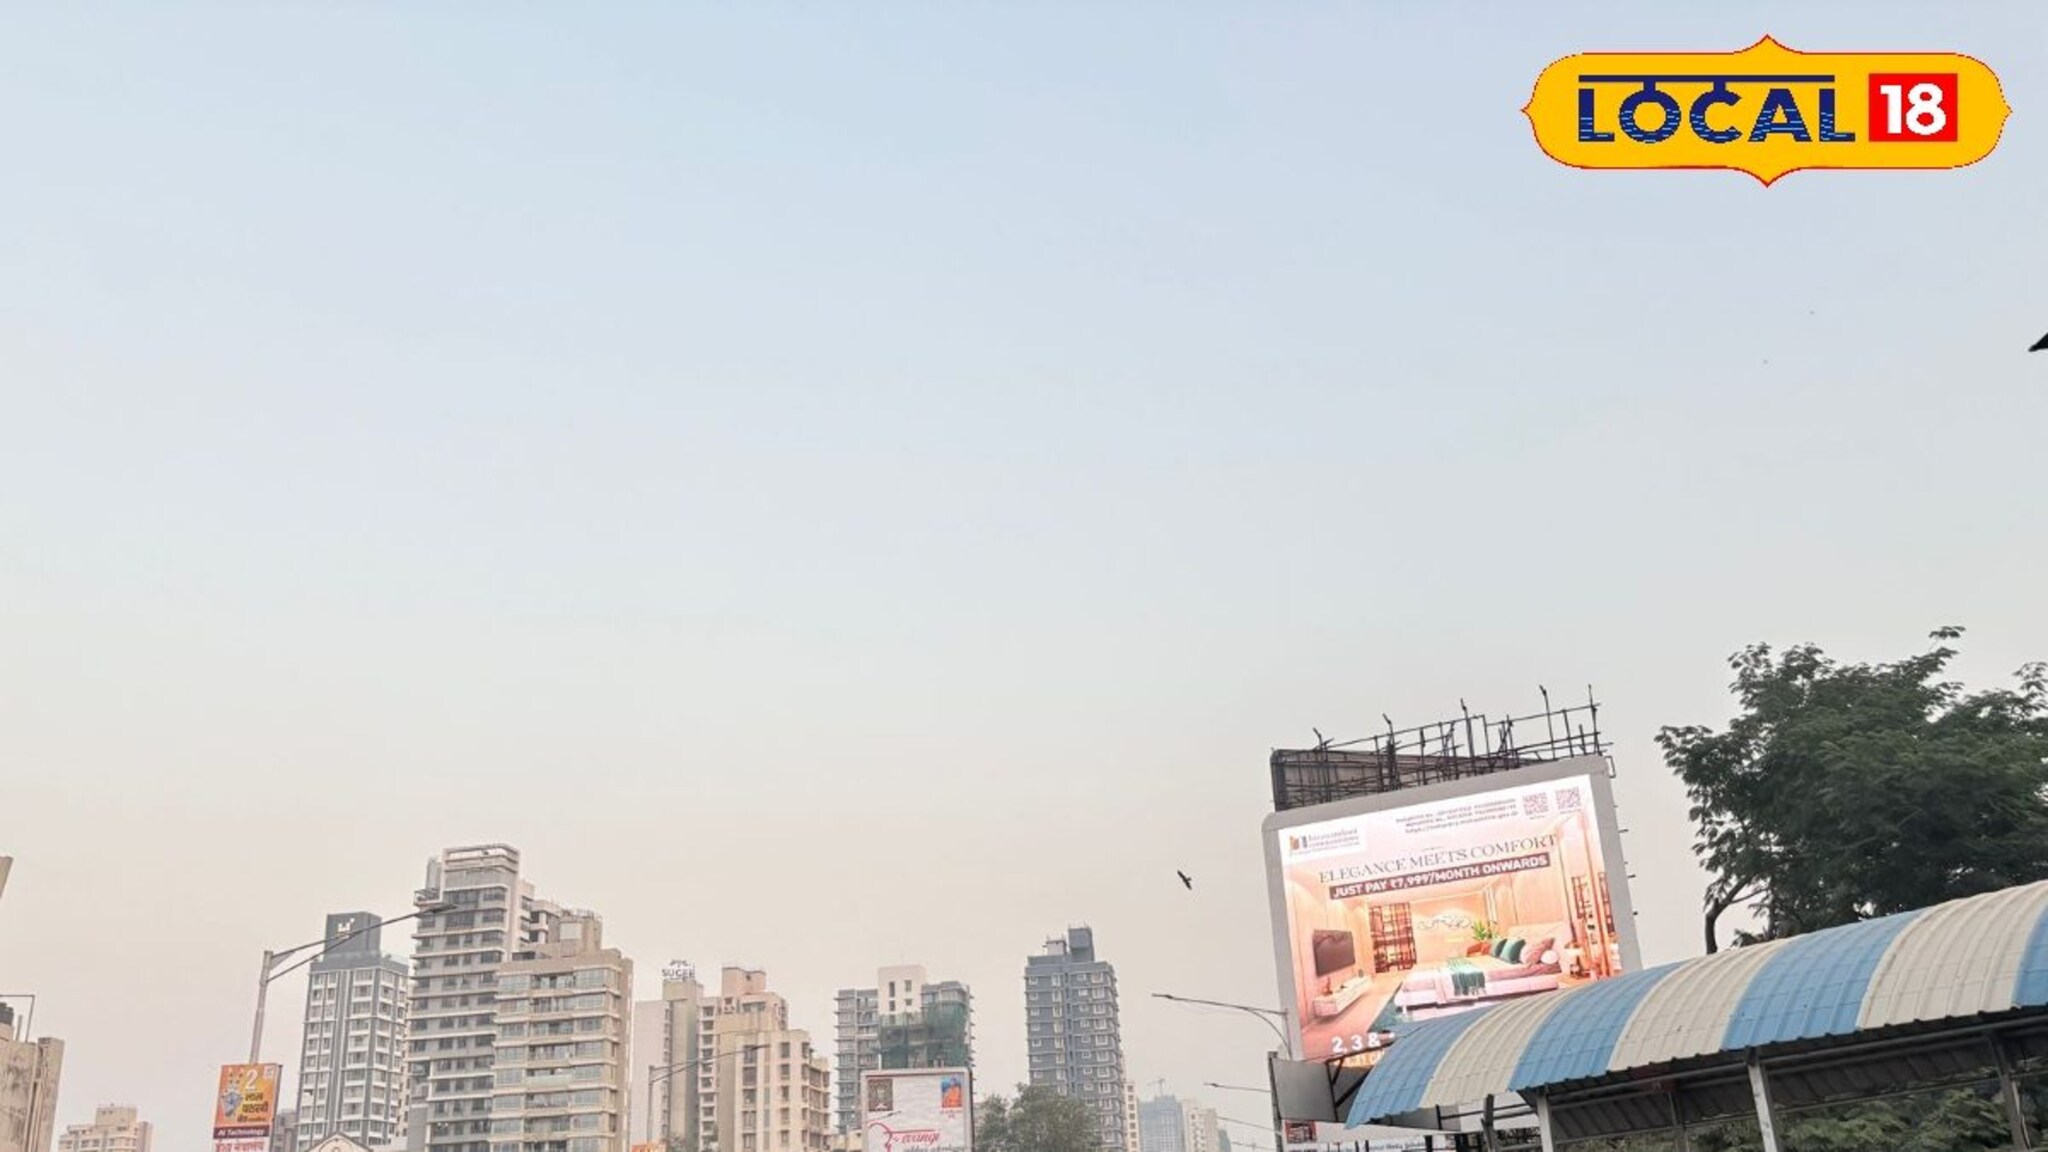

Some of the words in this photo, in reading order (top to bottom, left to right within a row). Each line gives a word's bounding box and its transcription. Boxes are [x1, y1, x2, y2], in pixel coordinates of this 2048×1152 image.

[1319, 857, 1406, 883] ELEGANCE
[1409, 848, 1468, 869] MEETS
[1471, 833, 1557, 857] COMFORT
[1334, 885, 1362, 899] JUST
[1365, 880, 1388, 893] PAY
[1483, 855, 1548, 873] ONWARDS
[1351, 1034, 1363, 1050] 3
[1367, 1032, 1381, 1048] &
[245, 1069, 258, 1089] 2
